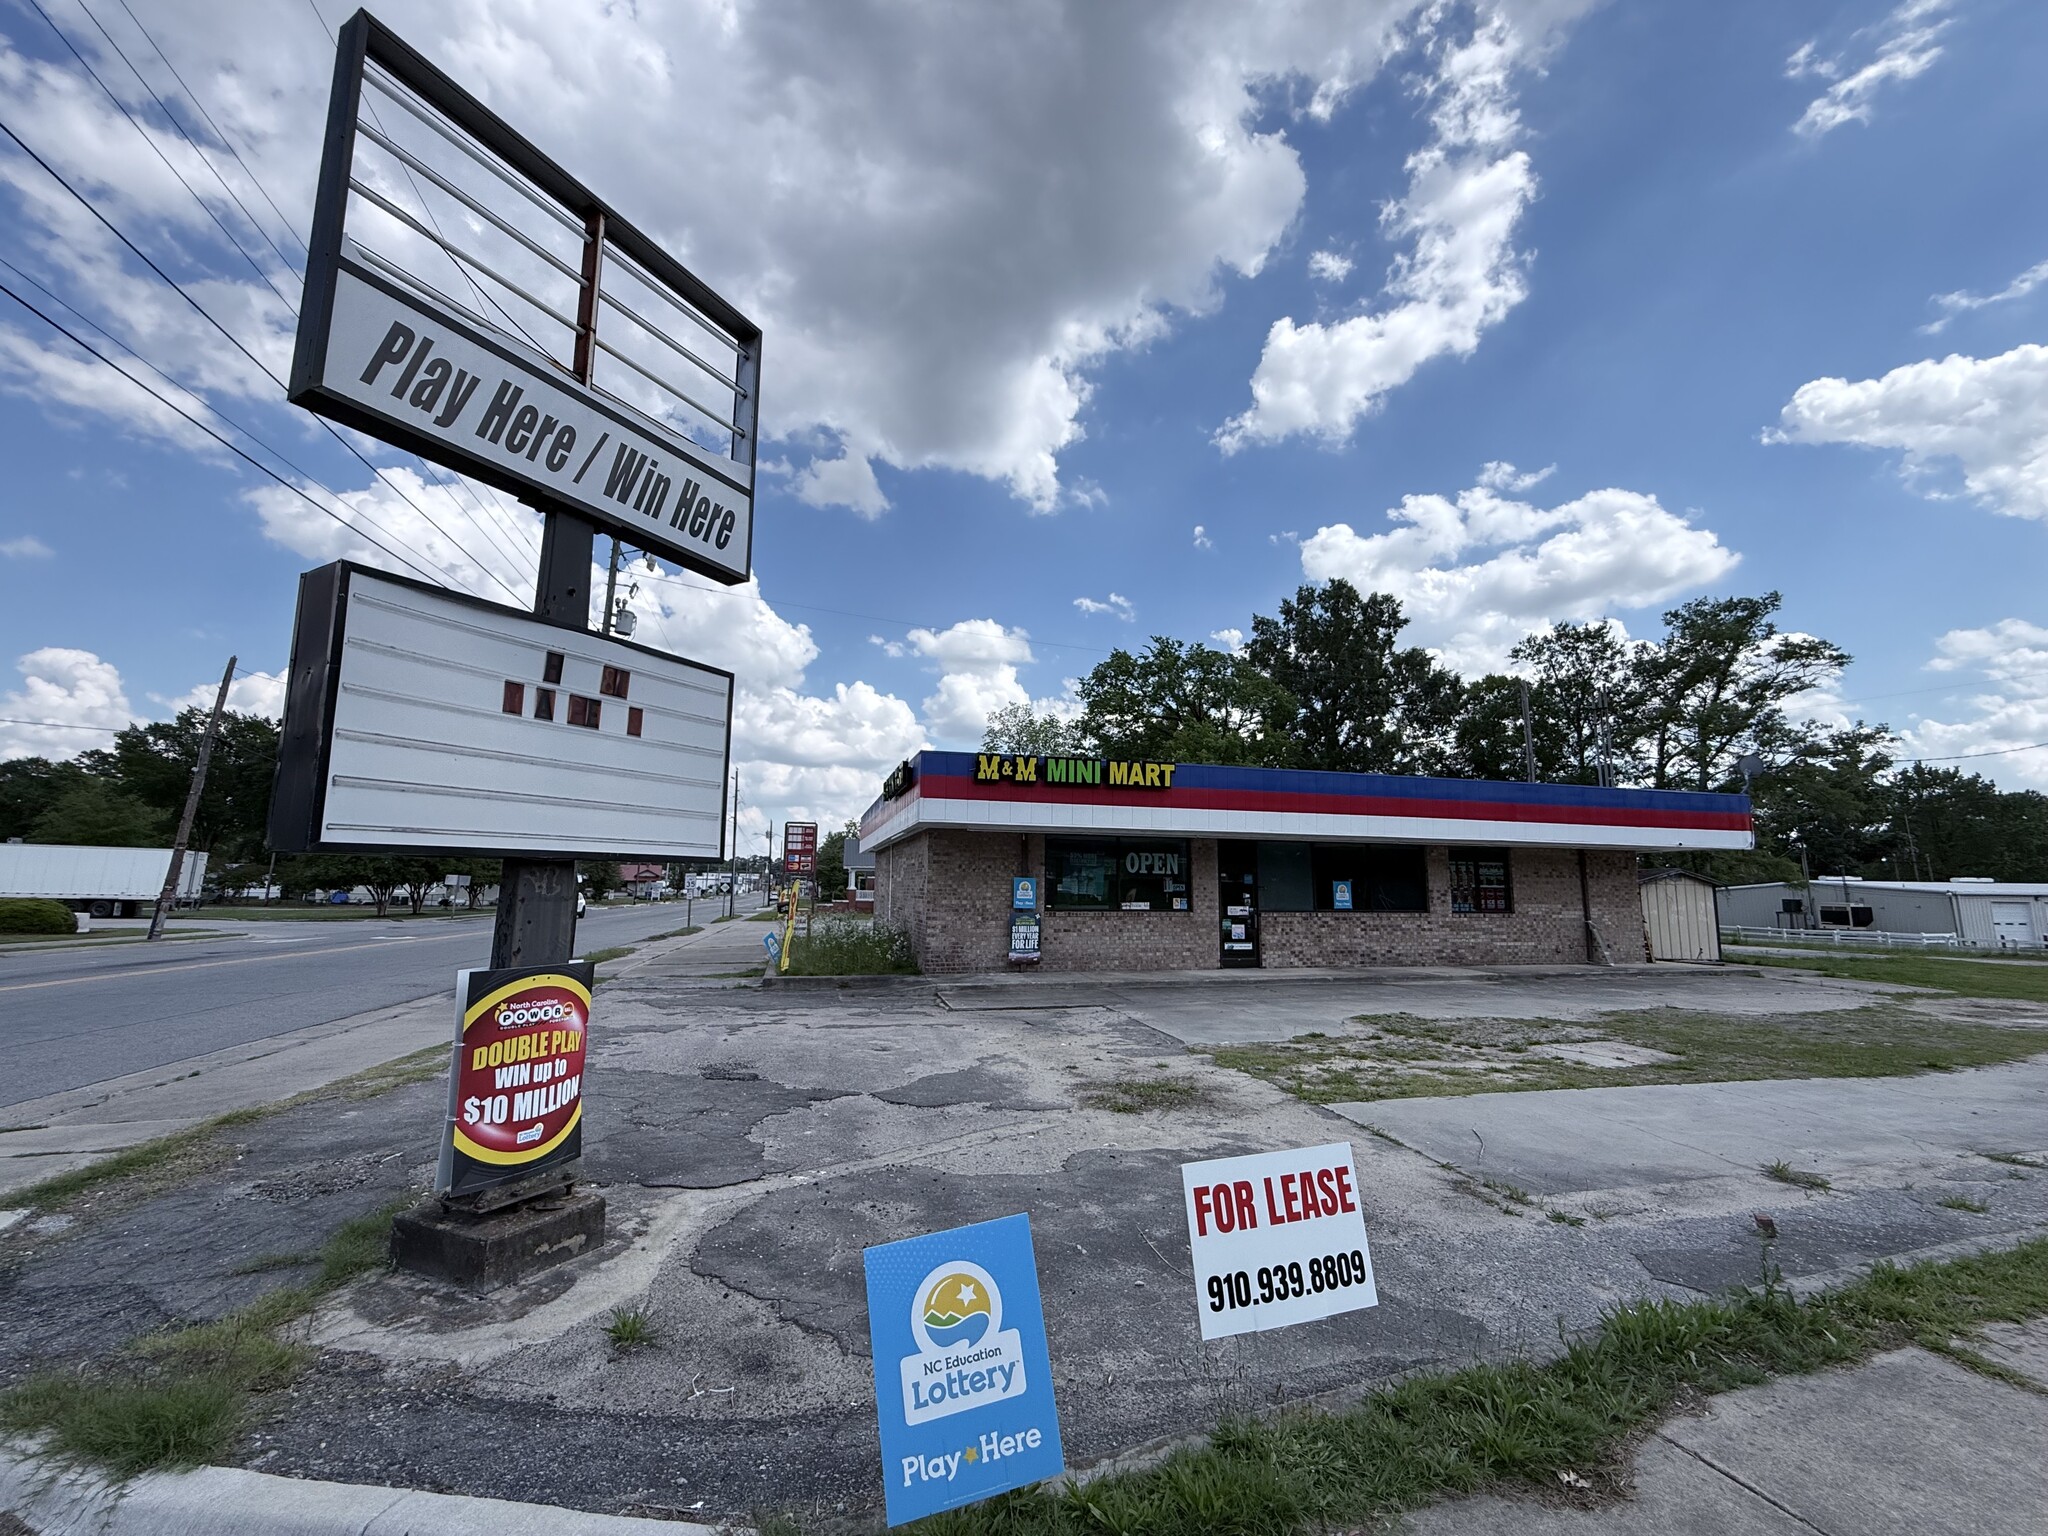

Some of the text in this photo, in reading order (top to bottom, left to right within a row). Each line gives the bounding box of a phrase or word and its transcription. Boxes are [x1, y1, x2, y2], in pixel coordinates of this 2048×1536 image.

[359, 321, 736, 551] Play Here / Win Here
[1046, 758, 1101, 785] MINI
[1108, 761, 1175, 787] MART
[1125, 852, 1179, 875] OPEN
[1012, 939, 1039, 949] FOR LIFE
[510, 999, 558, 1010] North Carolina
[472, 1030, 583, 1071] DOUBLE PLAY
[494, 1058, 567, 1090] WIN up to
[463, 1075, 581, 1126] $10 MILLION
[1193, 1165, 1356, 1237] FOR LEASE
[1207, 1249, 1367, 1313] 910.939.8809
[923, 1346, 1002, 1376] NC Education
[911, 1362, 1017, 1411] Lottery
[901, 1426, 1042, 1488] Play Here
